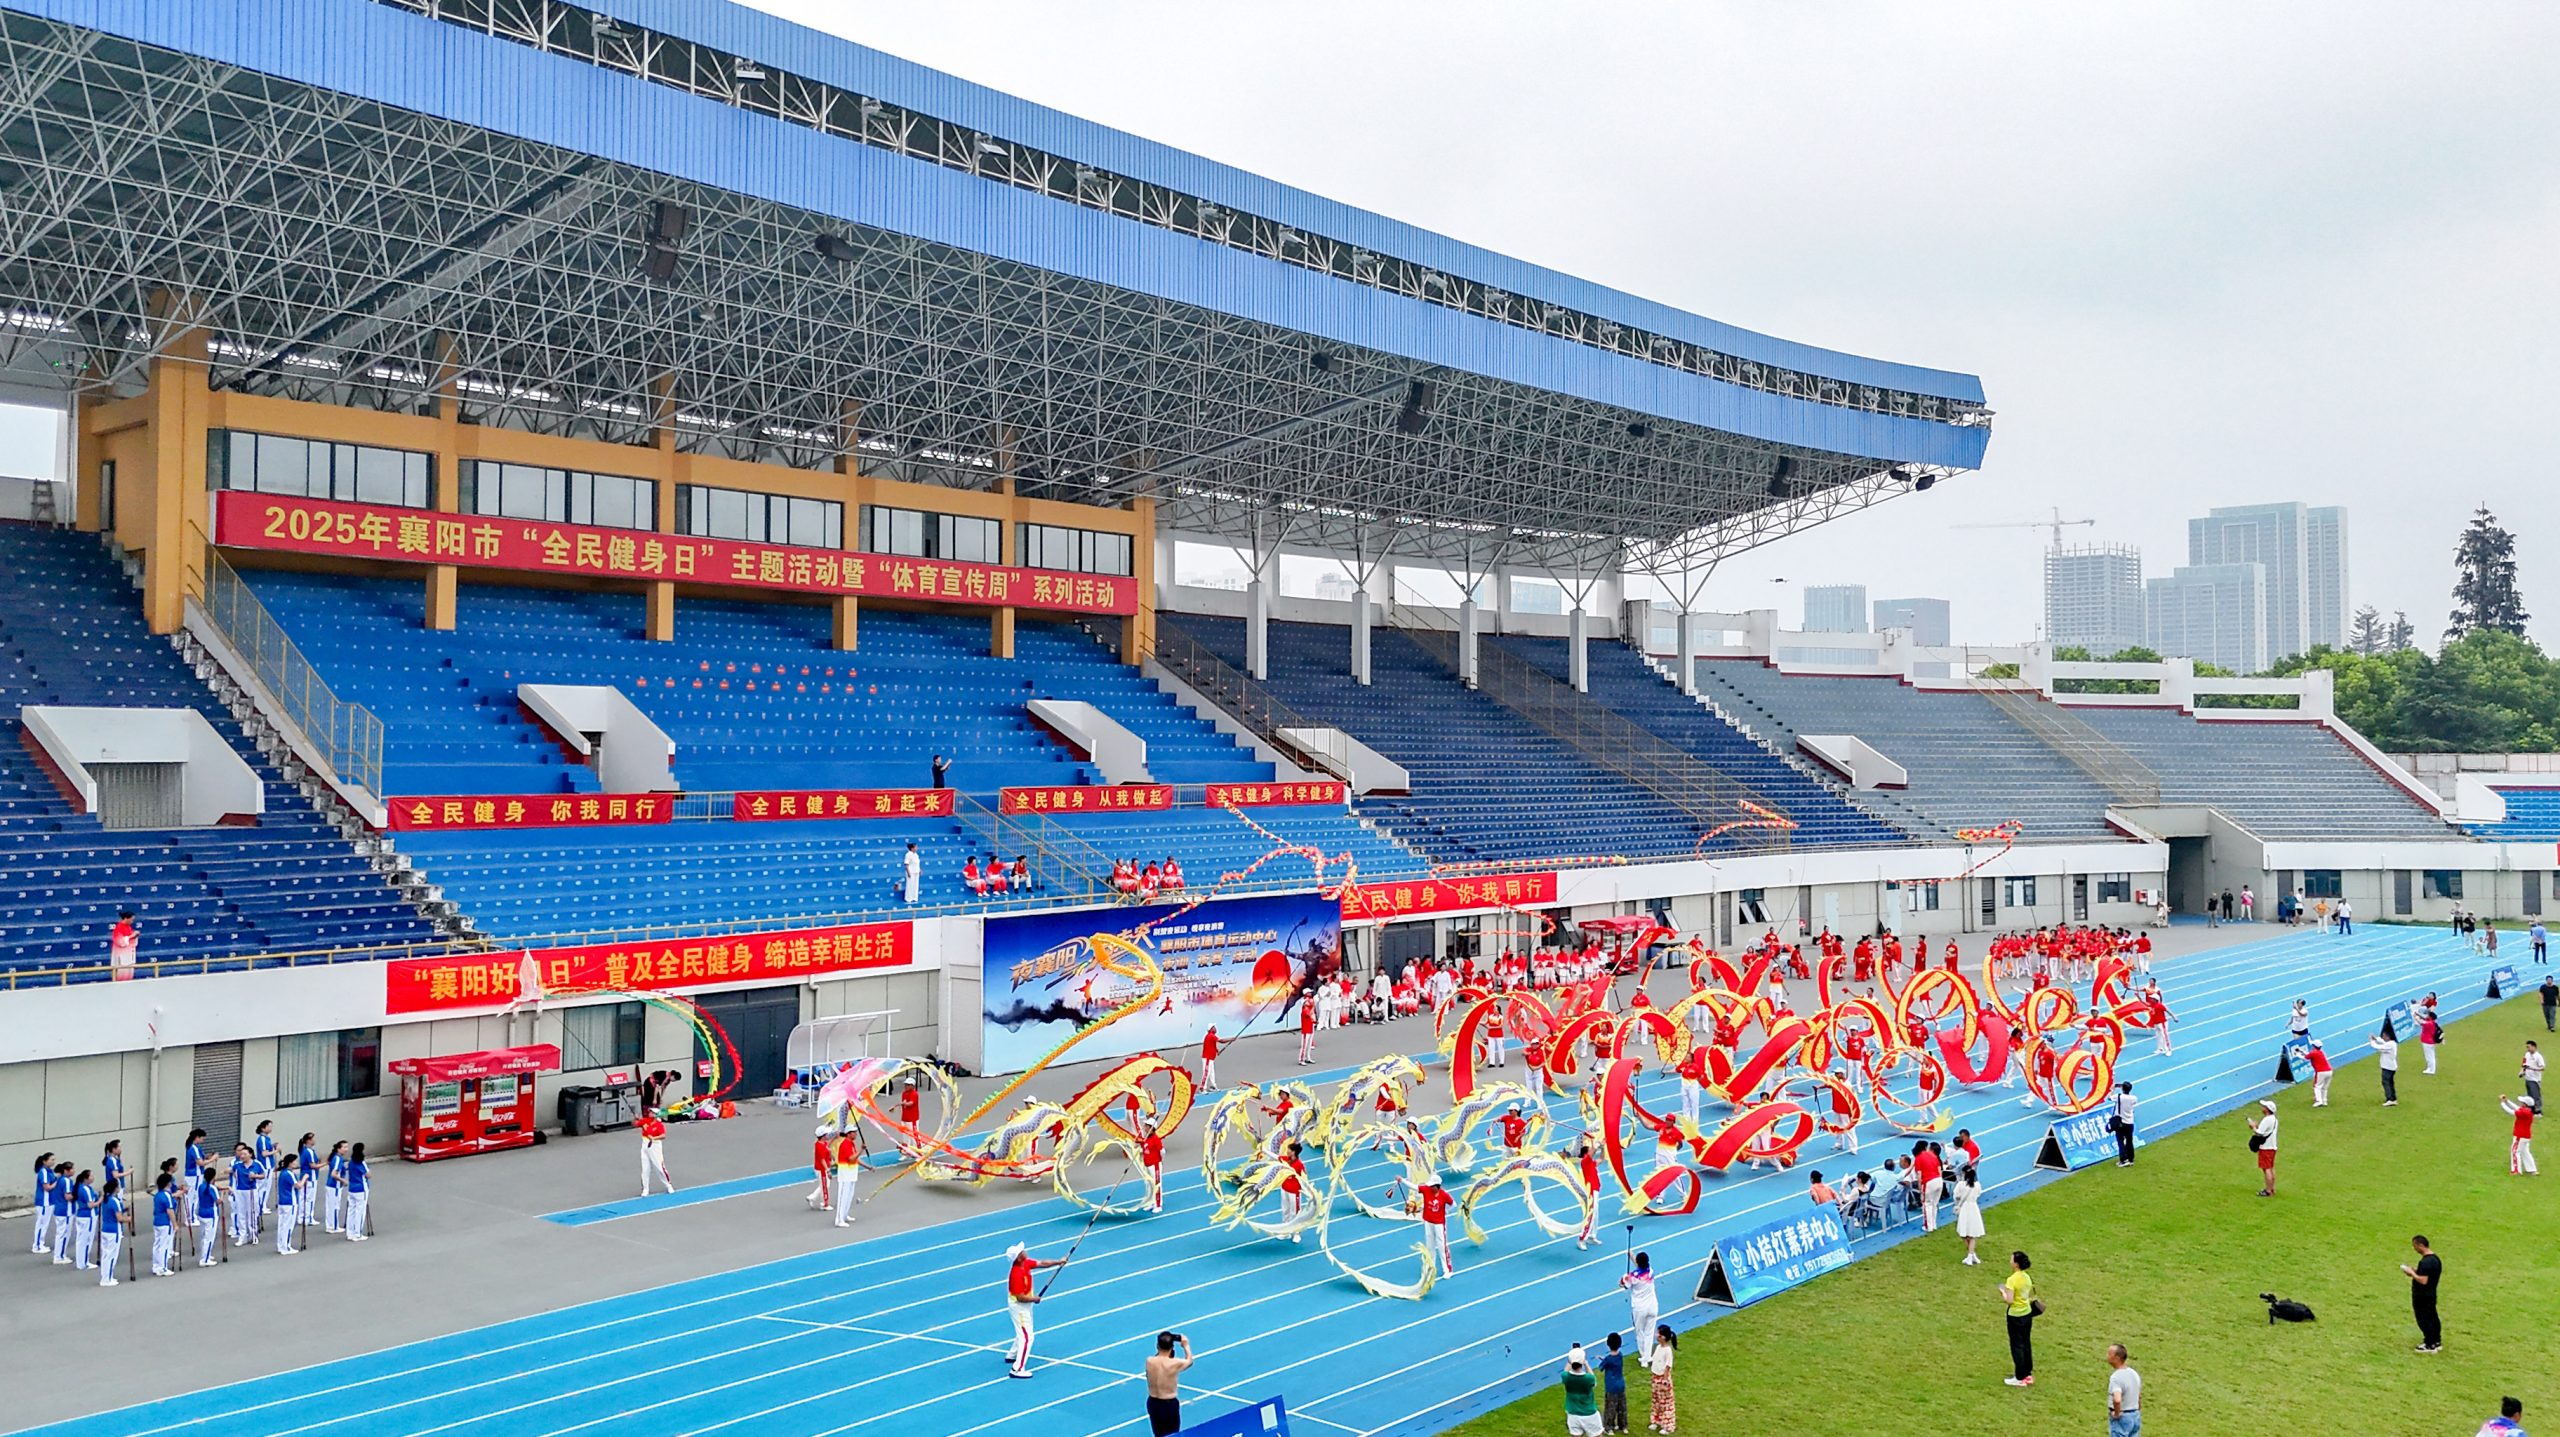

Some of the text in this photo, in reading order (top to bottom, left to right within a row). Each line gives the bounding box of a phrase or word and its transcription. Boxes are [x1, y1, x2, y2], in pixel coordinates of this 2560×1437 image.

[751, 793, 941, 816] 全民健身 动起来
[1015, 789, 1163, 810] 全民健身 从我做起
[1216, 785, 1336, 804] 全民健身 科学健身
[411, 798, 656, 825] 全民健身 你我同行
[1342, 878, 1542, 915] 全民健身 你我同行
[413, 930, 894, 1000] “襄阳好日” 普及全民健身 缔造幸福生活
[1745, 1213, 1839, 1272] 小桔灯素养中心
